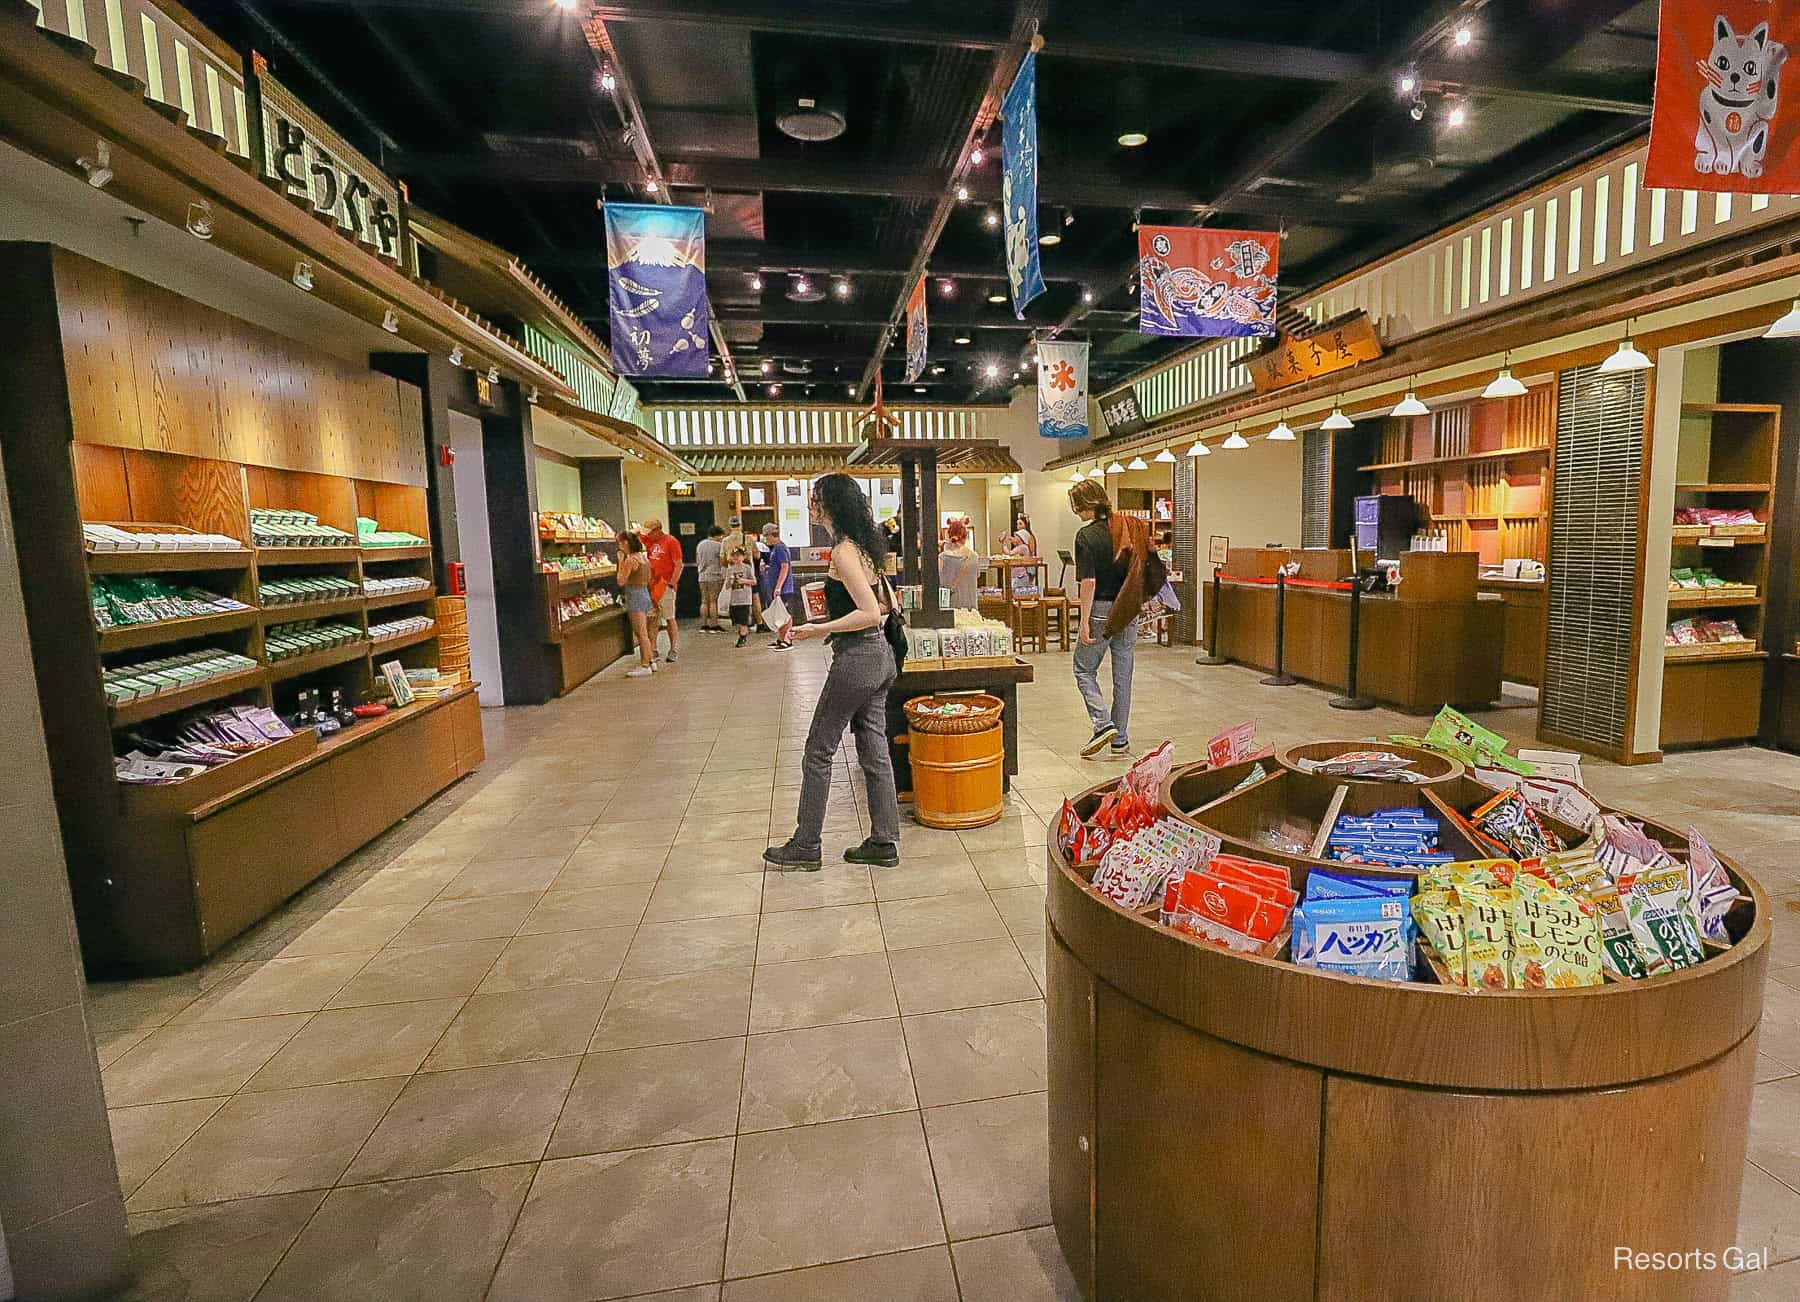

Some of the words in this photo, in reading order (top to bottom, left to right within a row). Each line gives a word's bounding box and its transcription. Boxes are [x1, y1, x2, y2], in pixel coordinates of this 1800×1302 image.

[274, 118, 399, 253] どうぐや
[630, 326, 653, 371] 初夢
[1049, 360, 1077, 392] 氷
